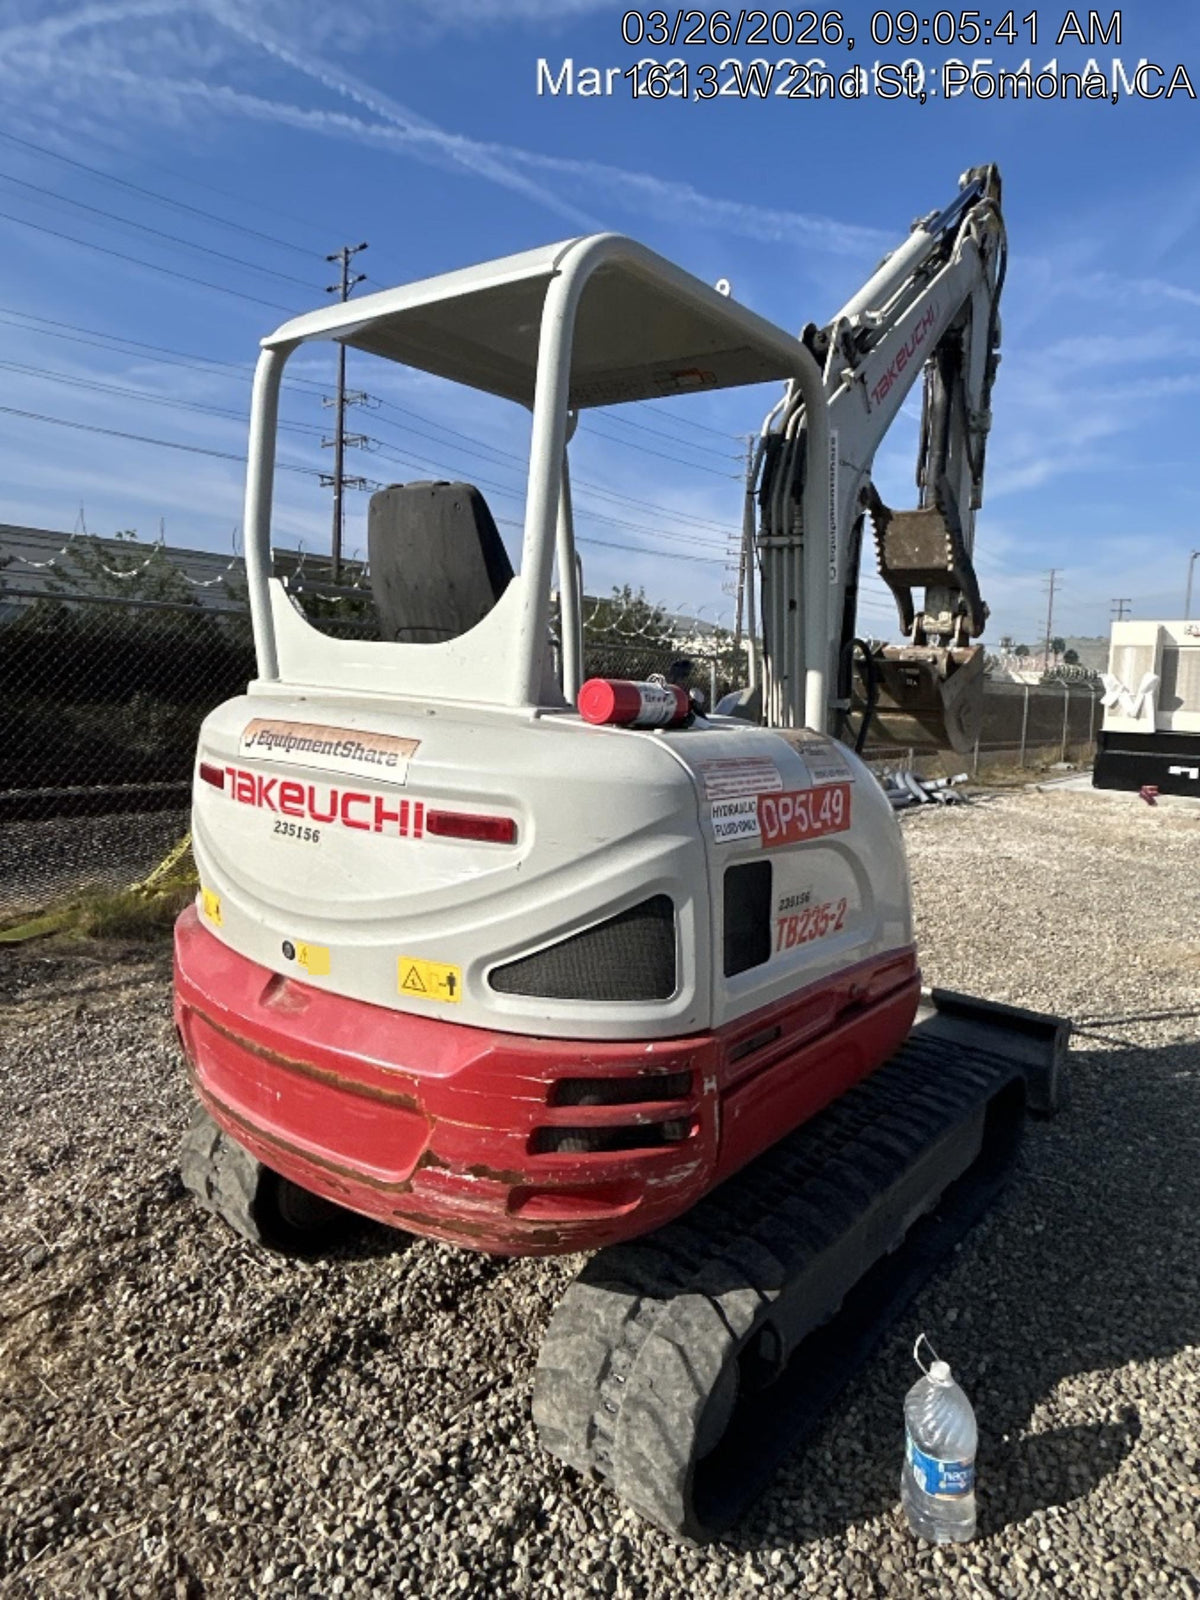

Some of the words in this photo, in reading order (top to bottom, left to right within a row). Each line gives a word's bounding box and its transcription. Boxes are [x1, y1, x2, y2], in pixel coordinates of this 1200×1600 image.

[257, 730, 398, 767] EquipmentShare
[712, 802, 756, 818] HYDRAULIC
[762, 789, 844, 839] DP5L49
[273, 820, 320, 843] 235156
[776, 897, 847, 952] TB235-2
